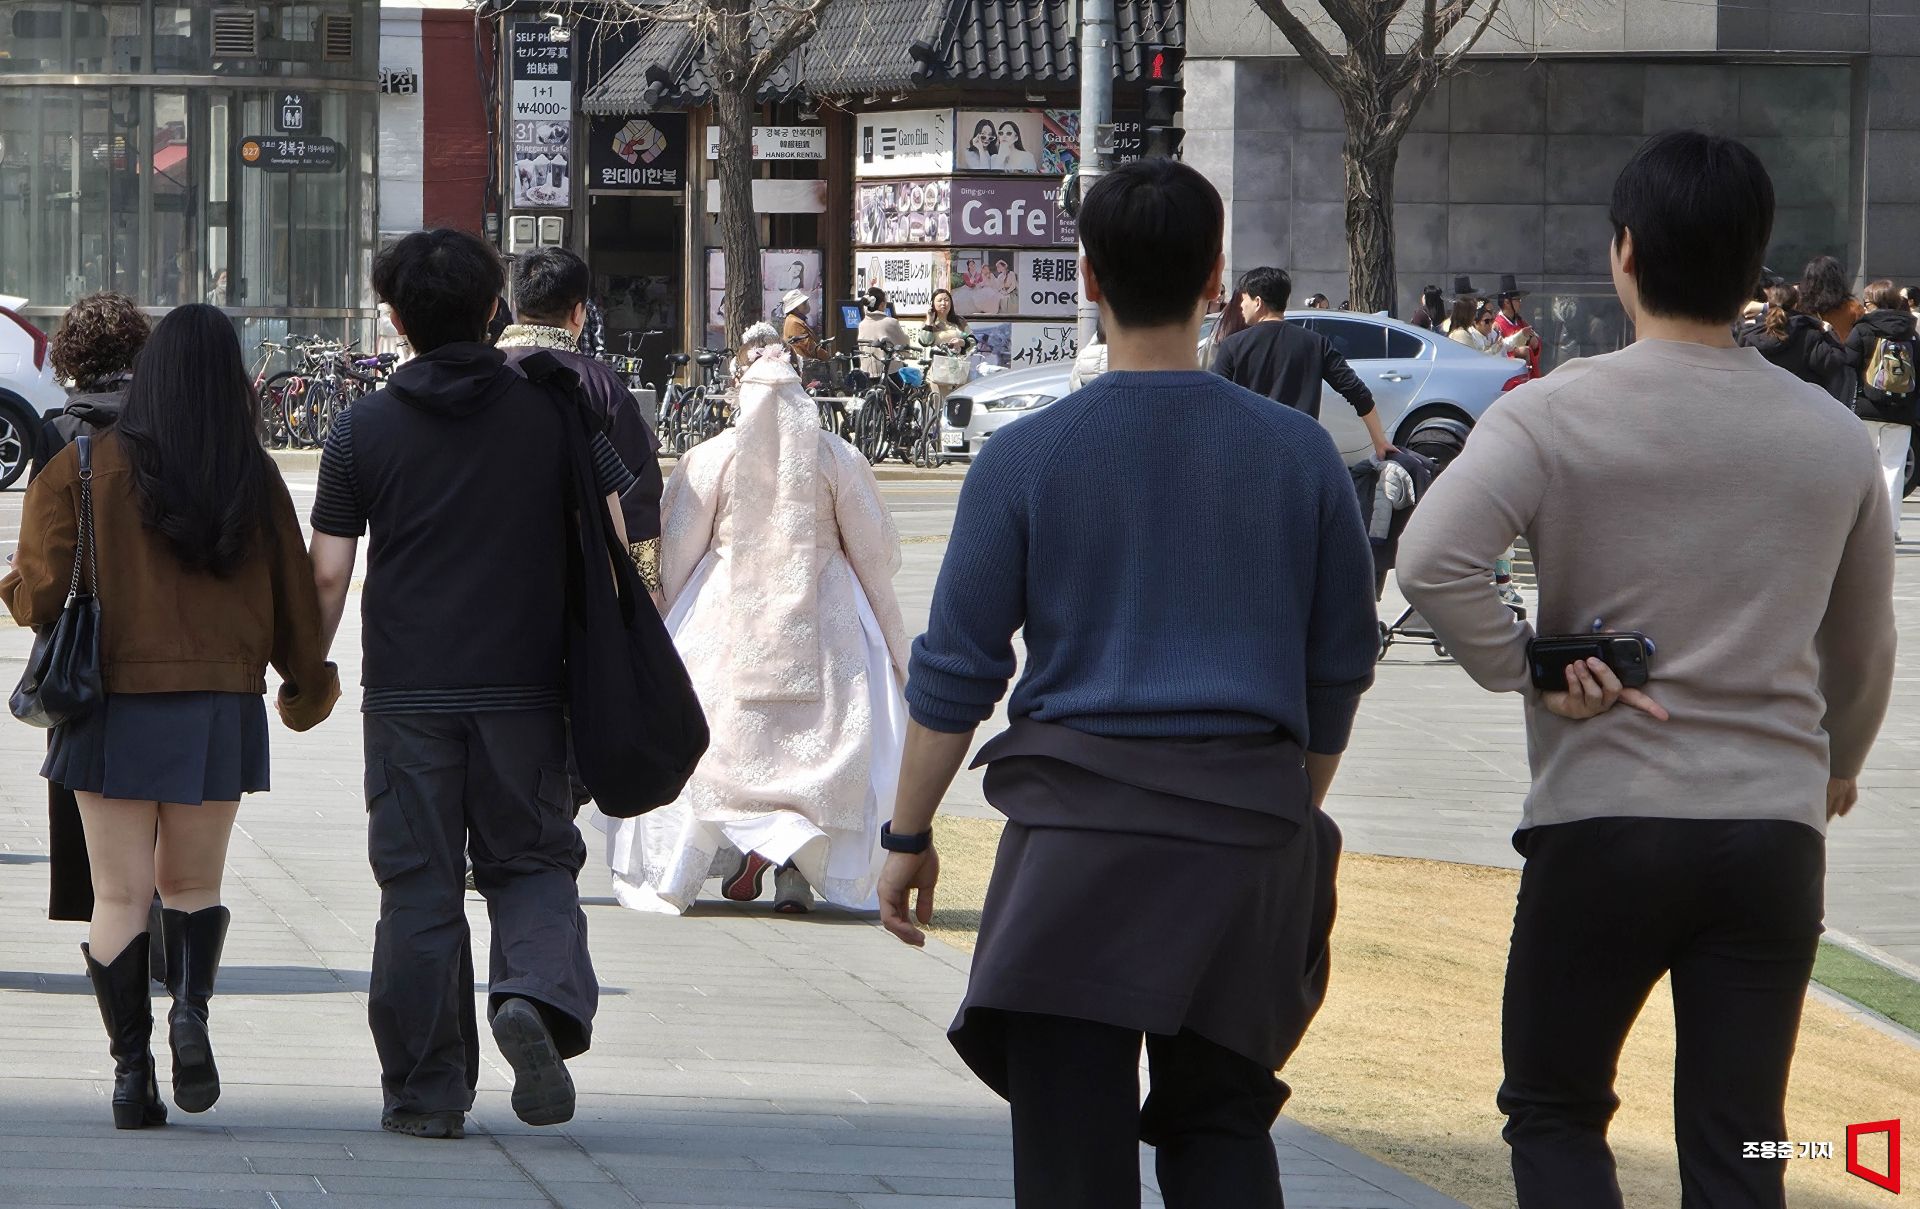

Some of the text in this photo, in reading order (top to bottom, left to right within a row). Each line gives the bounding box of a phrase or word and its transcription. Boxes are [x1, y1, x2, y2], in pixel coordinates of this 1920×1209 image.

[516, 33, 551, 42] SELF PH
[516, 47, 568, 58] セルフ写真
[532, 86, 553, 97] 1+1
[1113, 122, 1130, 132] ELF
[766, 129, 789, 138] 경복궁
[243, 147, 259, 156] 327
[278, 141, 305, 155] 경복궁
[602, 168, 677, 185] 원데이한복
[1043, 186, 1060, 200] wi
[961, 200, 1047, 235] Cafe
